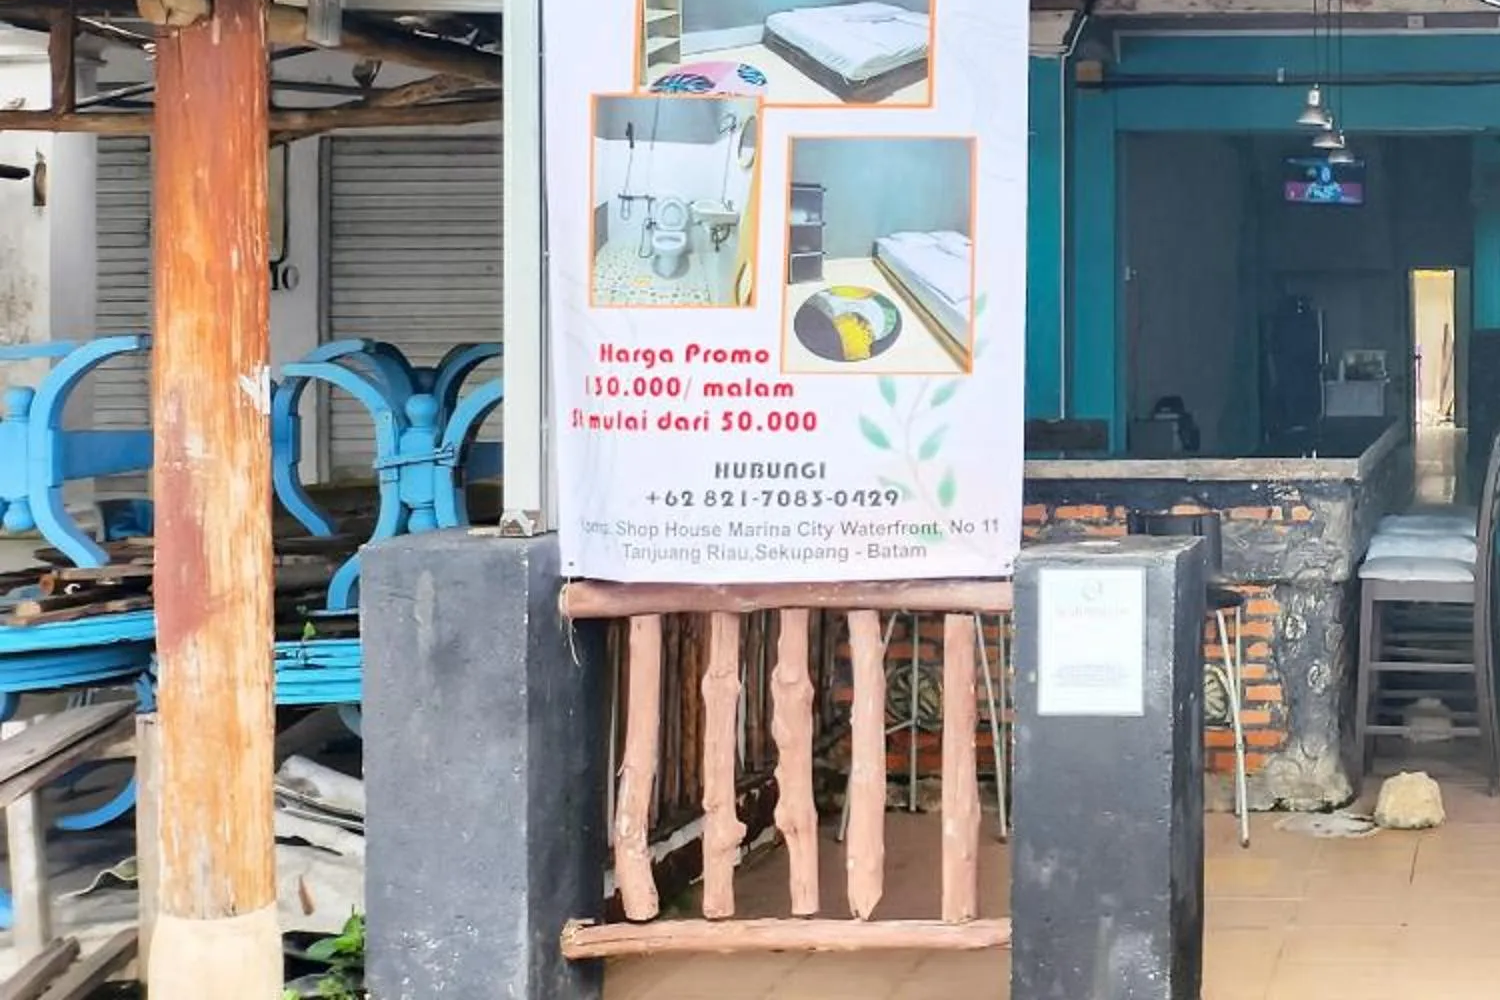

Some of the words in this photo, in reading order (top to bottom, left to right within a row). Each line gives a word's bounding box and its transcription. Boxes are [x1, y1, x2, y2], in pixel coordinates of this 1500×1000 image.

[599, 343, 674, 369] Harga
[684, 343, 770, 364] Promo
[703, 377, 795, 398] malam
[657, 410, 710, 431] dari
[720, 410, 818, 431] 50.000
[714, 461, 827, 480] HUBUNGI
[645, 488, 696, 508] +62
[703, 488, 899, 508] 821-7083-0429
[615, 519, 660, 541] Shop
[665, 520, 722, 538] House
[728, 519, 791, 538] Marina
[797, 518, 834, 541] City
[839, 518, 945, 538] Waterfront,
[950, 518, 976, 535] No
[983, 518, 1000, 533] 11
[623, 543, 701, 565] Tanjuang
[867, 543, 928, 560] Batam
